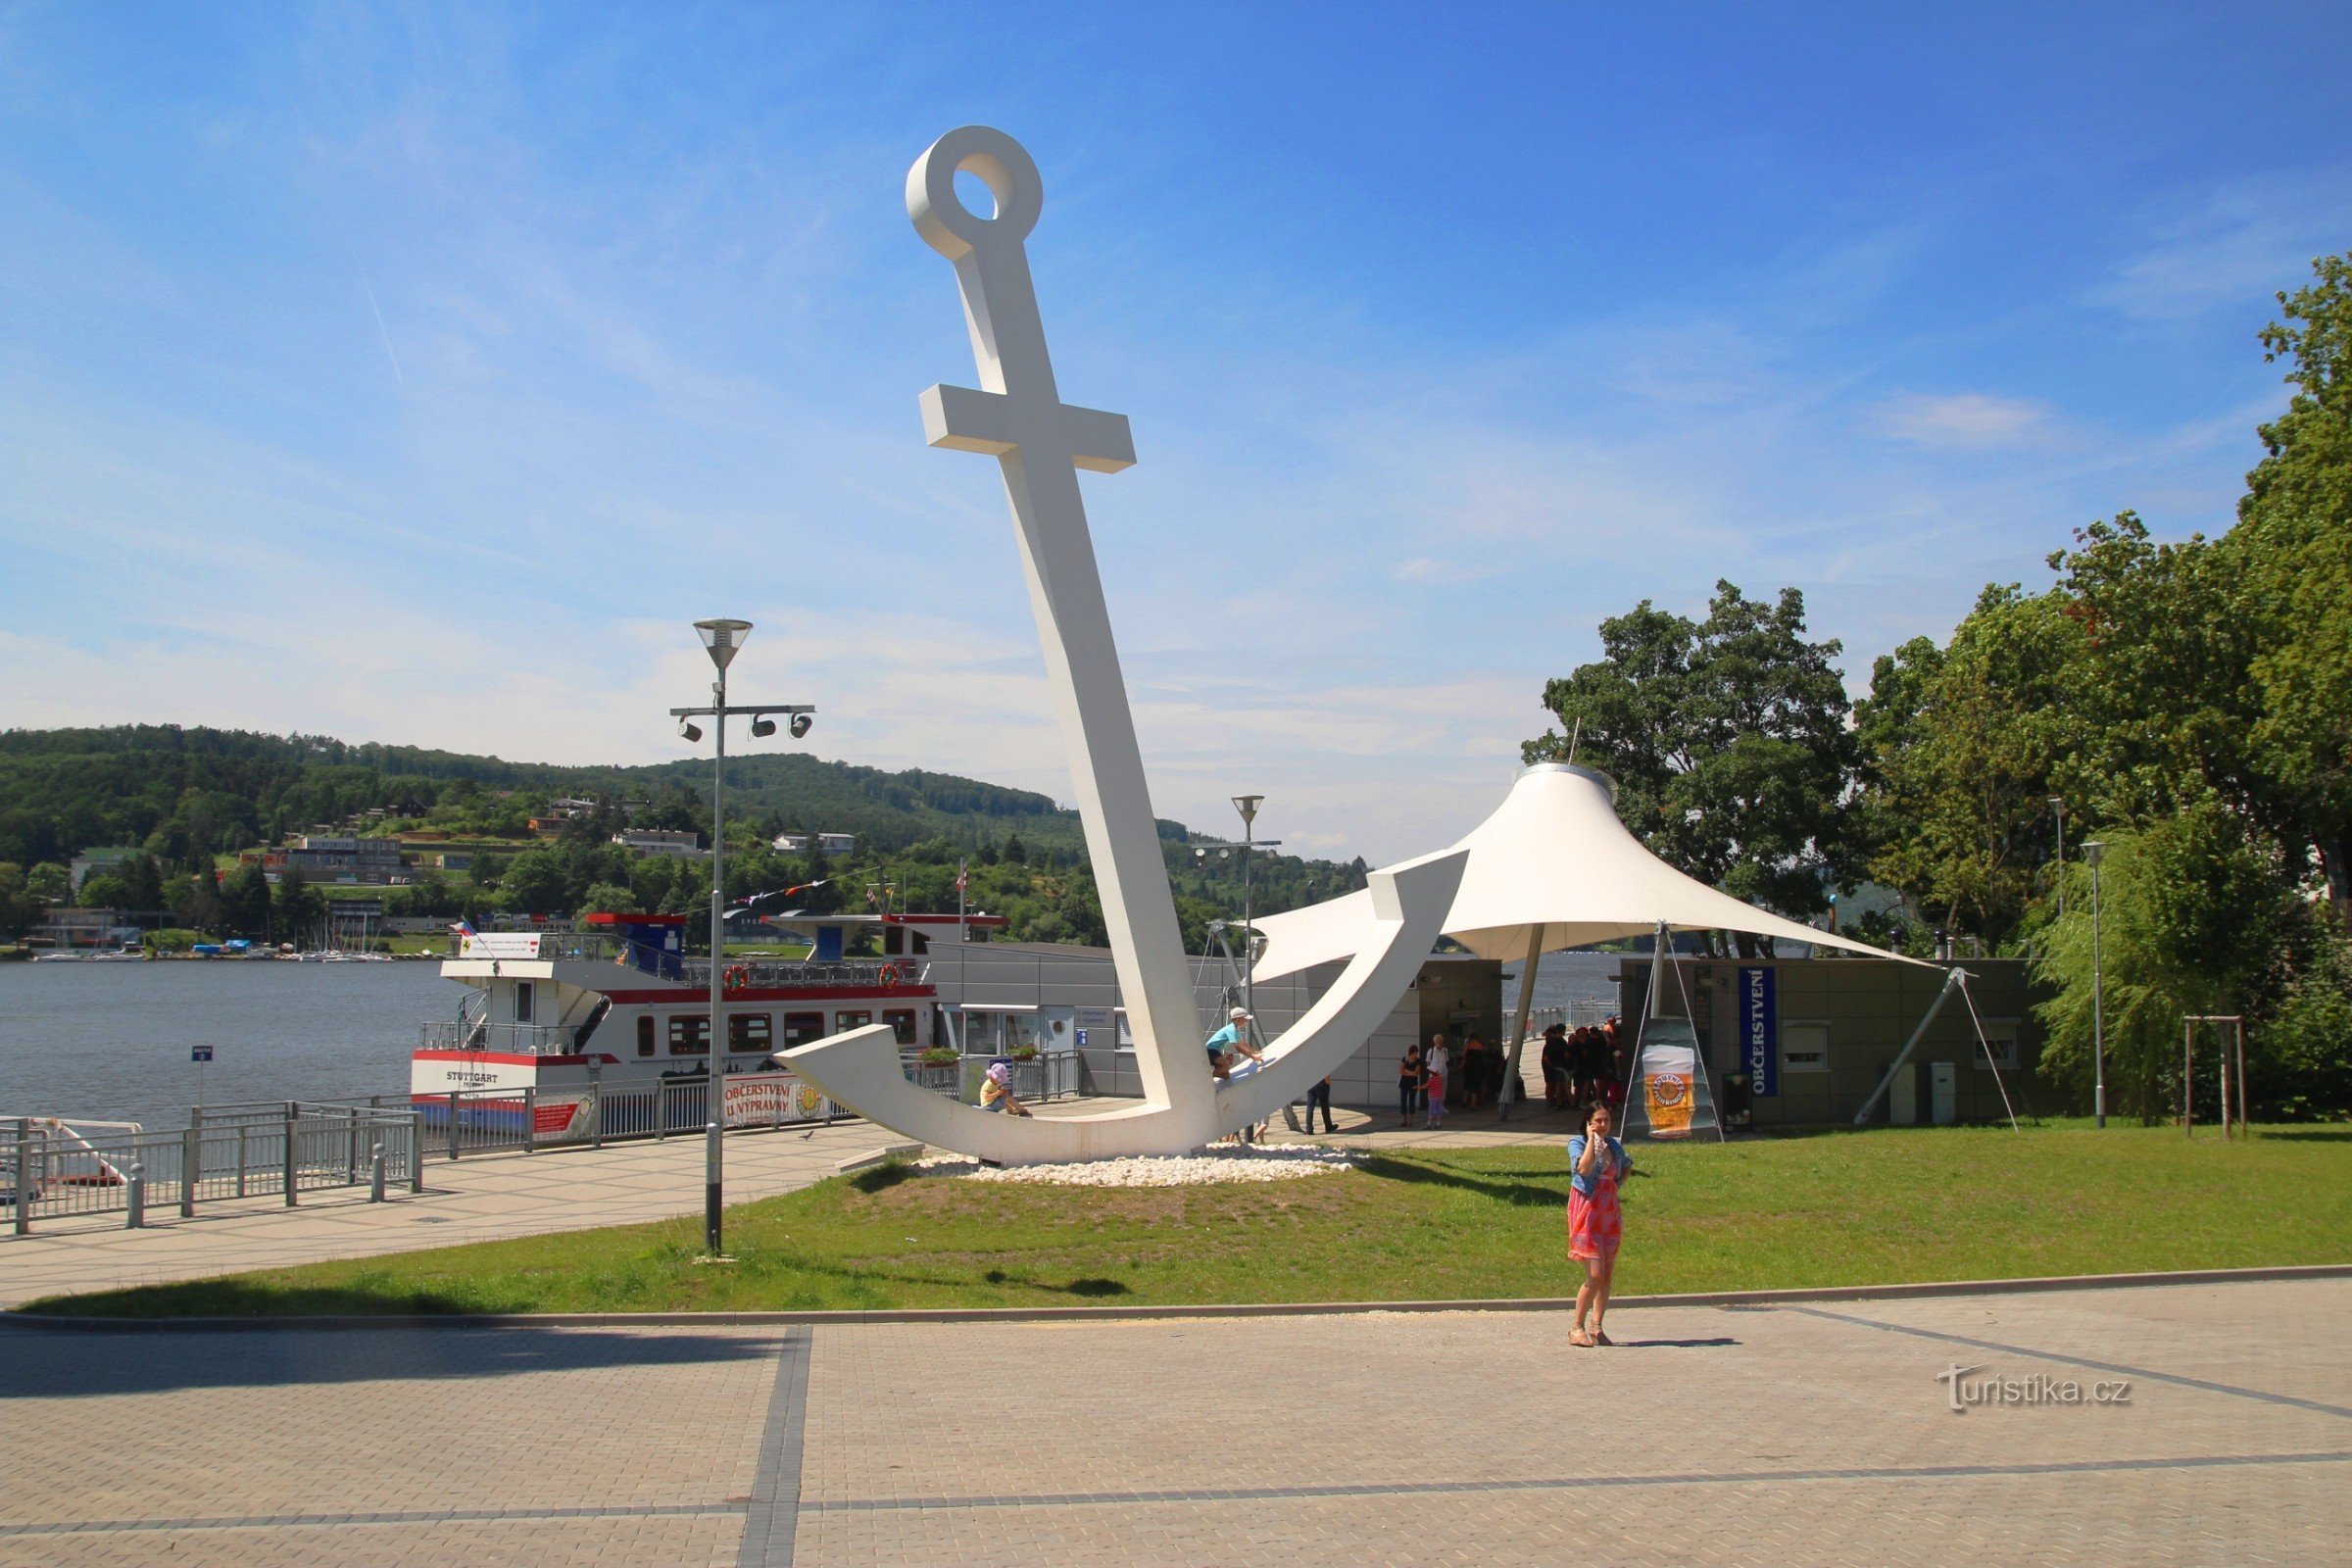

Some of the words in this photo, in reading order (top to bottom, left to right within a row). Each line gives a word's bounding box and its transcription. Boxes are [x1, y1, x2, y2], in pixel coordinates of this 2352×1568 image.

[1748, 969, 1765, 1095] OBČERSTVENÍ
[447, 1071, 498, 1084] STUTTGART
[725, 1083, 792, 1101] OBČERSTVENÍ
[737, 1098, 788, 1113] VÝPRAVNY
